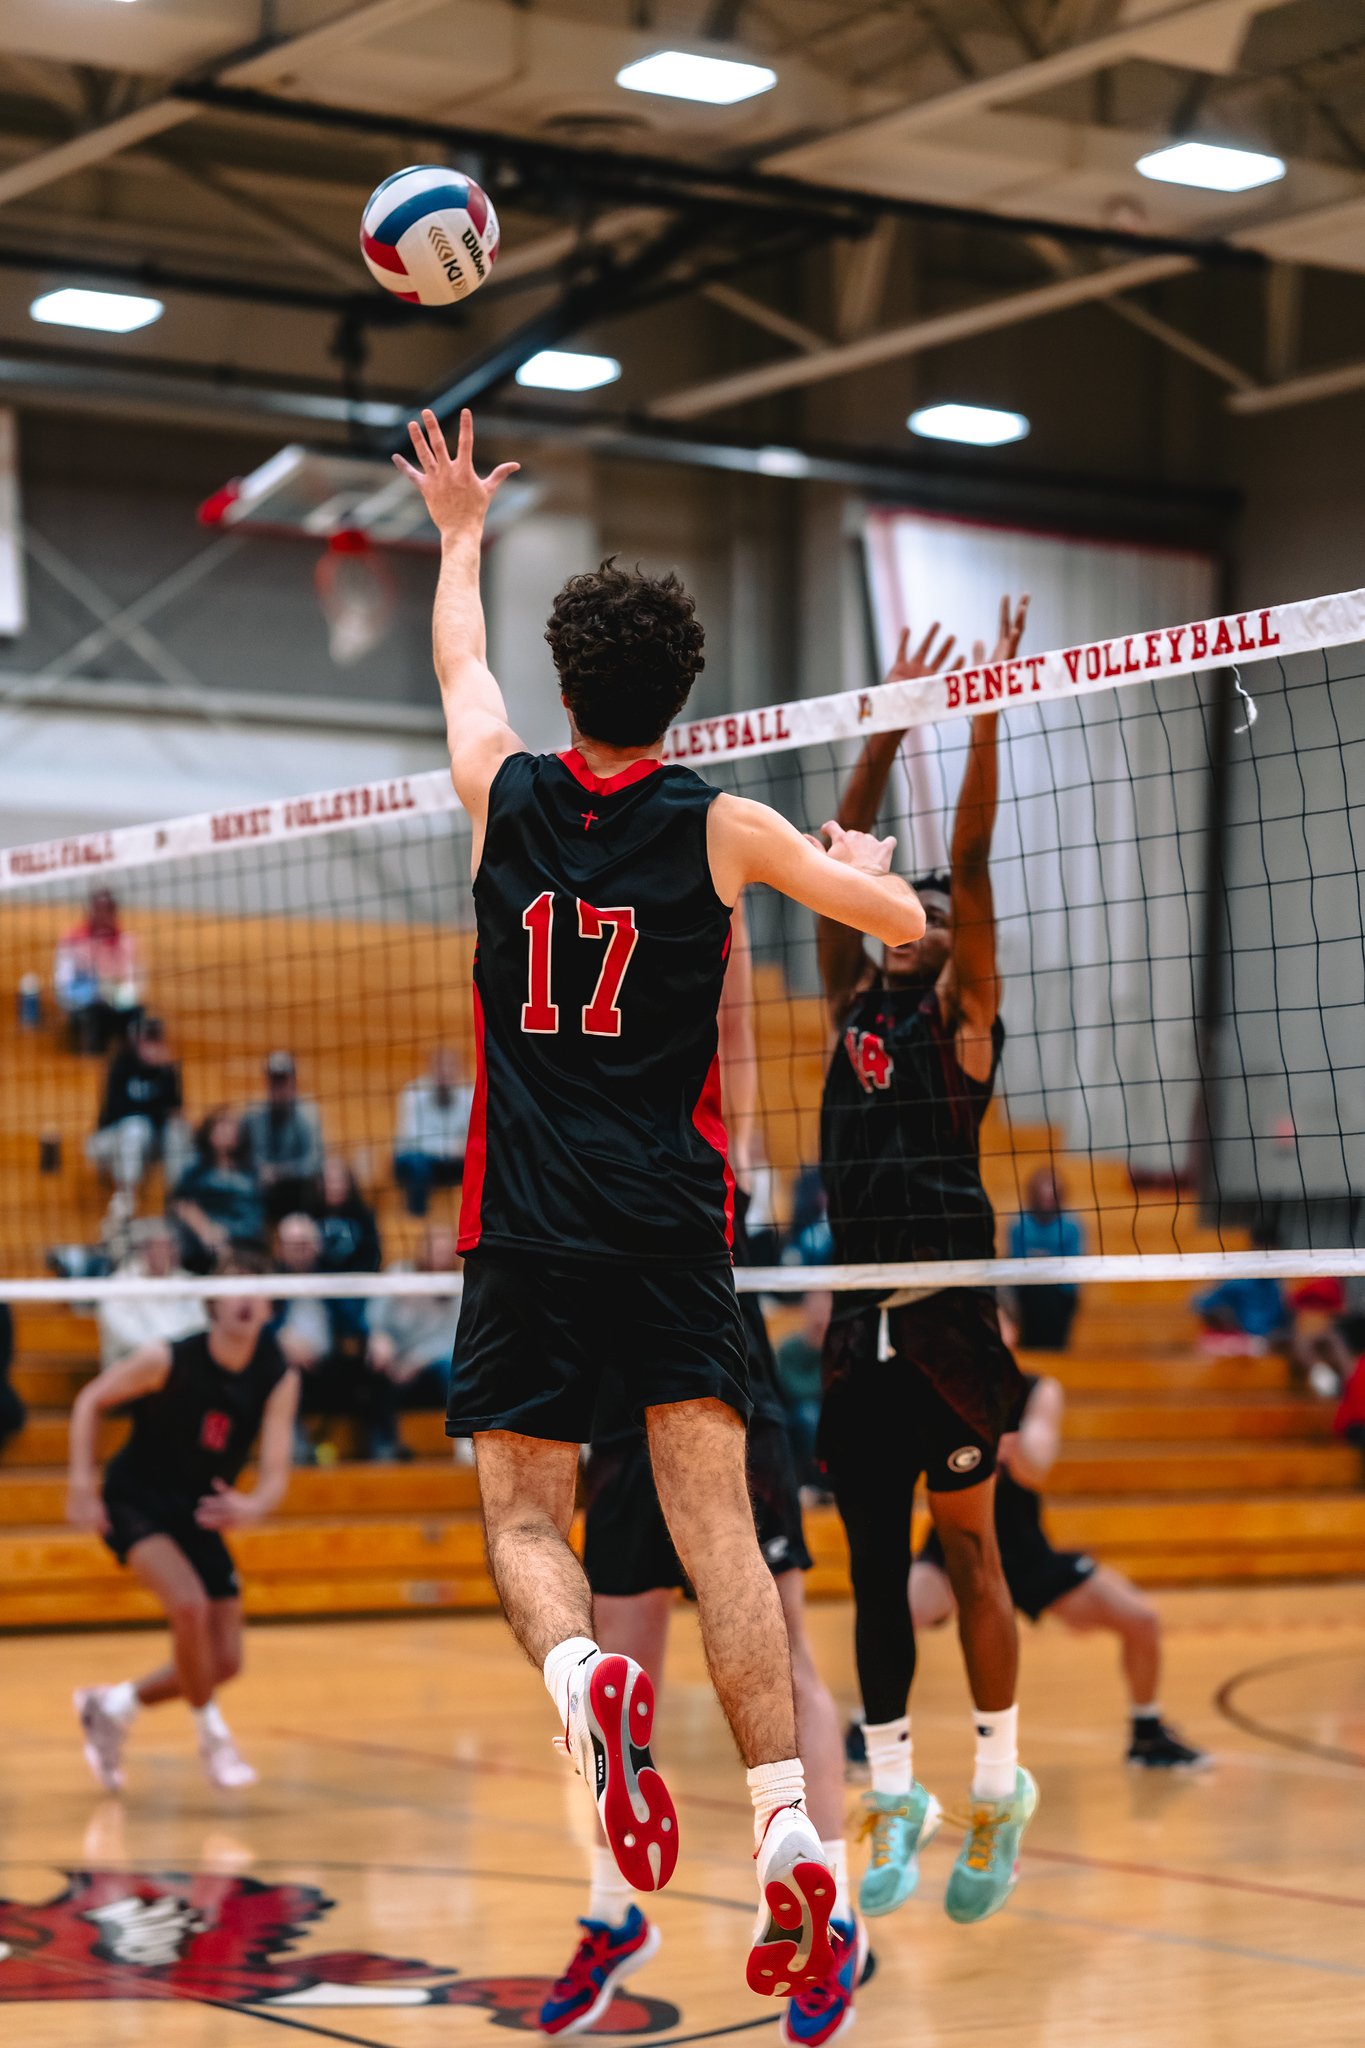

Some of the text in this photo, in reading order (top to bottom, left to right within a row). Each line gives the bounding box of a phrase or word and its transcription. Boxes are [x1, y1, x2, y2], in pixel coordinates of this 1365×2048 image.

[461, 227, 485, 281] Wilson
[943, 610, 1281, 709] BENET VOLLEYBALL
[662, 708, 791, 760] LEYBALL
[520, 890, 639, 1038] 17
